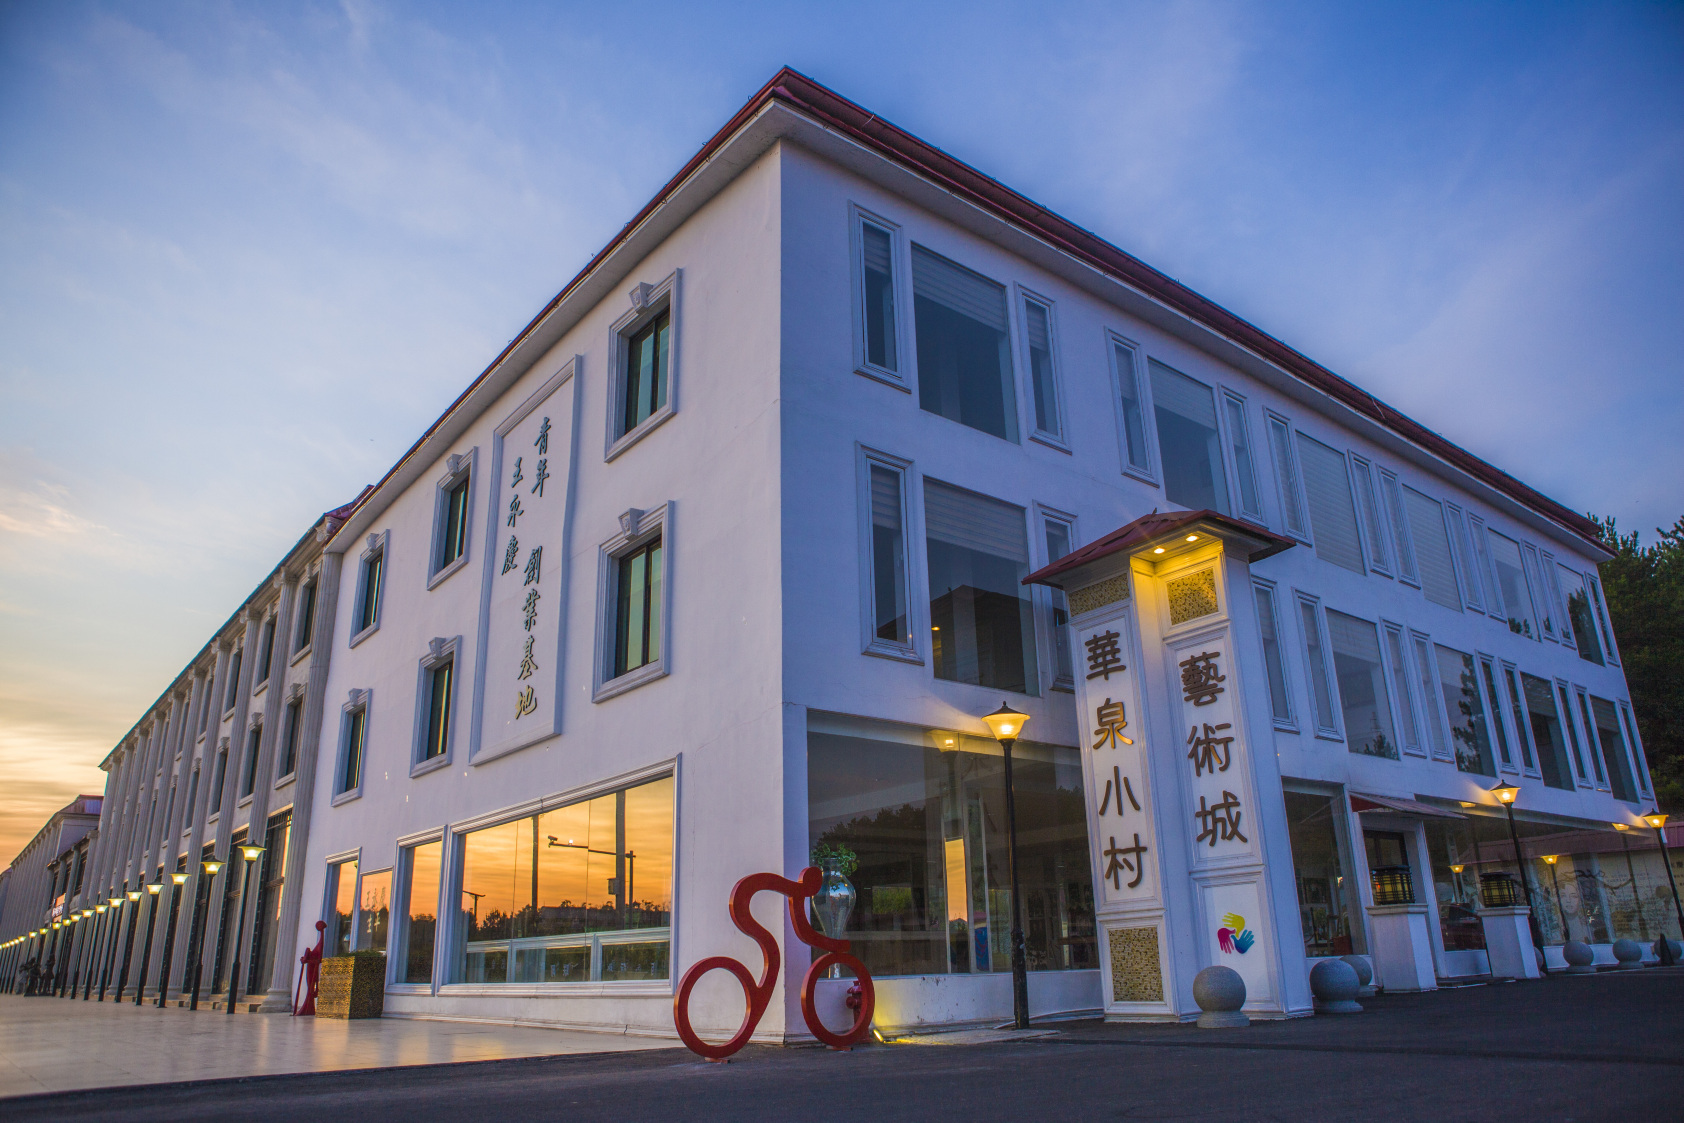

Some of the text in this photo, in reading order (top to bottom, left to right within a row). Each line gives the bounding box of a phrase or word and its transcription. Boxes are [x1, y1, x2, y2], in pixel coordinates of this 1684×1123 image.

[1085, 630, 1148, 890] 華泉小村
[1179, 651, 1248, 847] 藝術城
